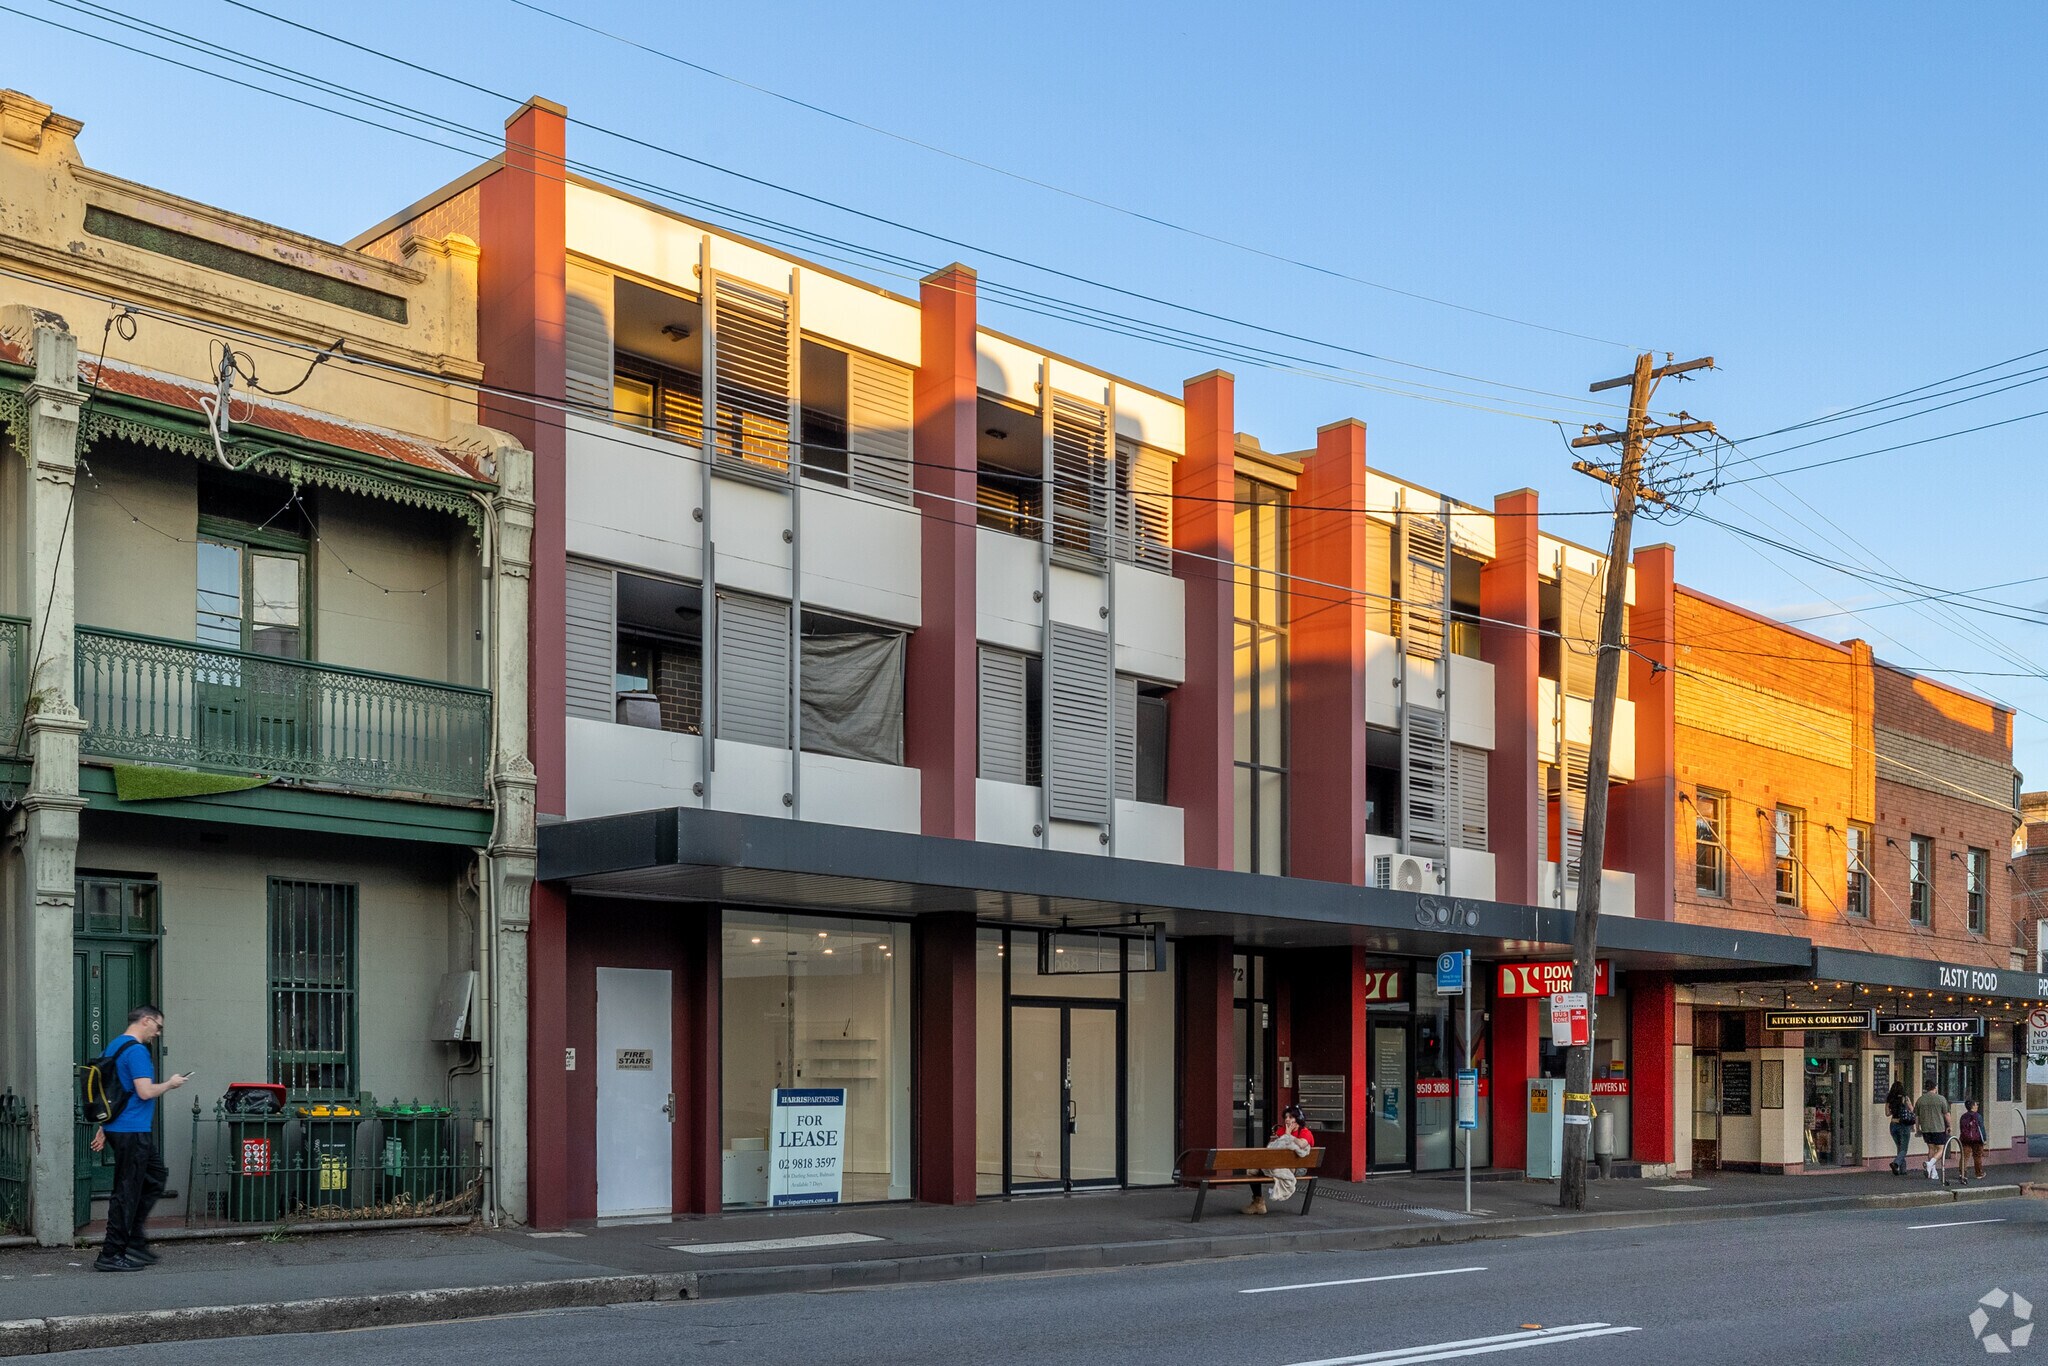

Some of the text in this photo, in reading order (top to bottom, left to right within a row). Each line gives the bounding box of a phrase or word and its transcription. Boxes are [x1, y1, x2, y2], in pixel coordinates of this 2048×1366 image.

[1415, 895, 1480, 928] Soho
[1544, 965, 1602, 979] DOWN
[1939, 966, 1998, 991] TASTY FOOD
[92, 1006, 100, 1045] 566
[1771, 1015, 1865, 1025] KITCHEN & COURTYARD
[1888, 1022, 1969, 1032] BOTTLE SHOP
[2033, 1030, 2048, 1038] NO
[1416, 1083, 1432, 1094] 9519
[1592, 1082, 1618, 1092] LAWYERS
[797, 1115, 823, 1126] FOR
[779, 1130, 838, 1148] LEASE
[778, 1156, 837, 1170] 02 9818 3597
